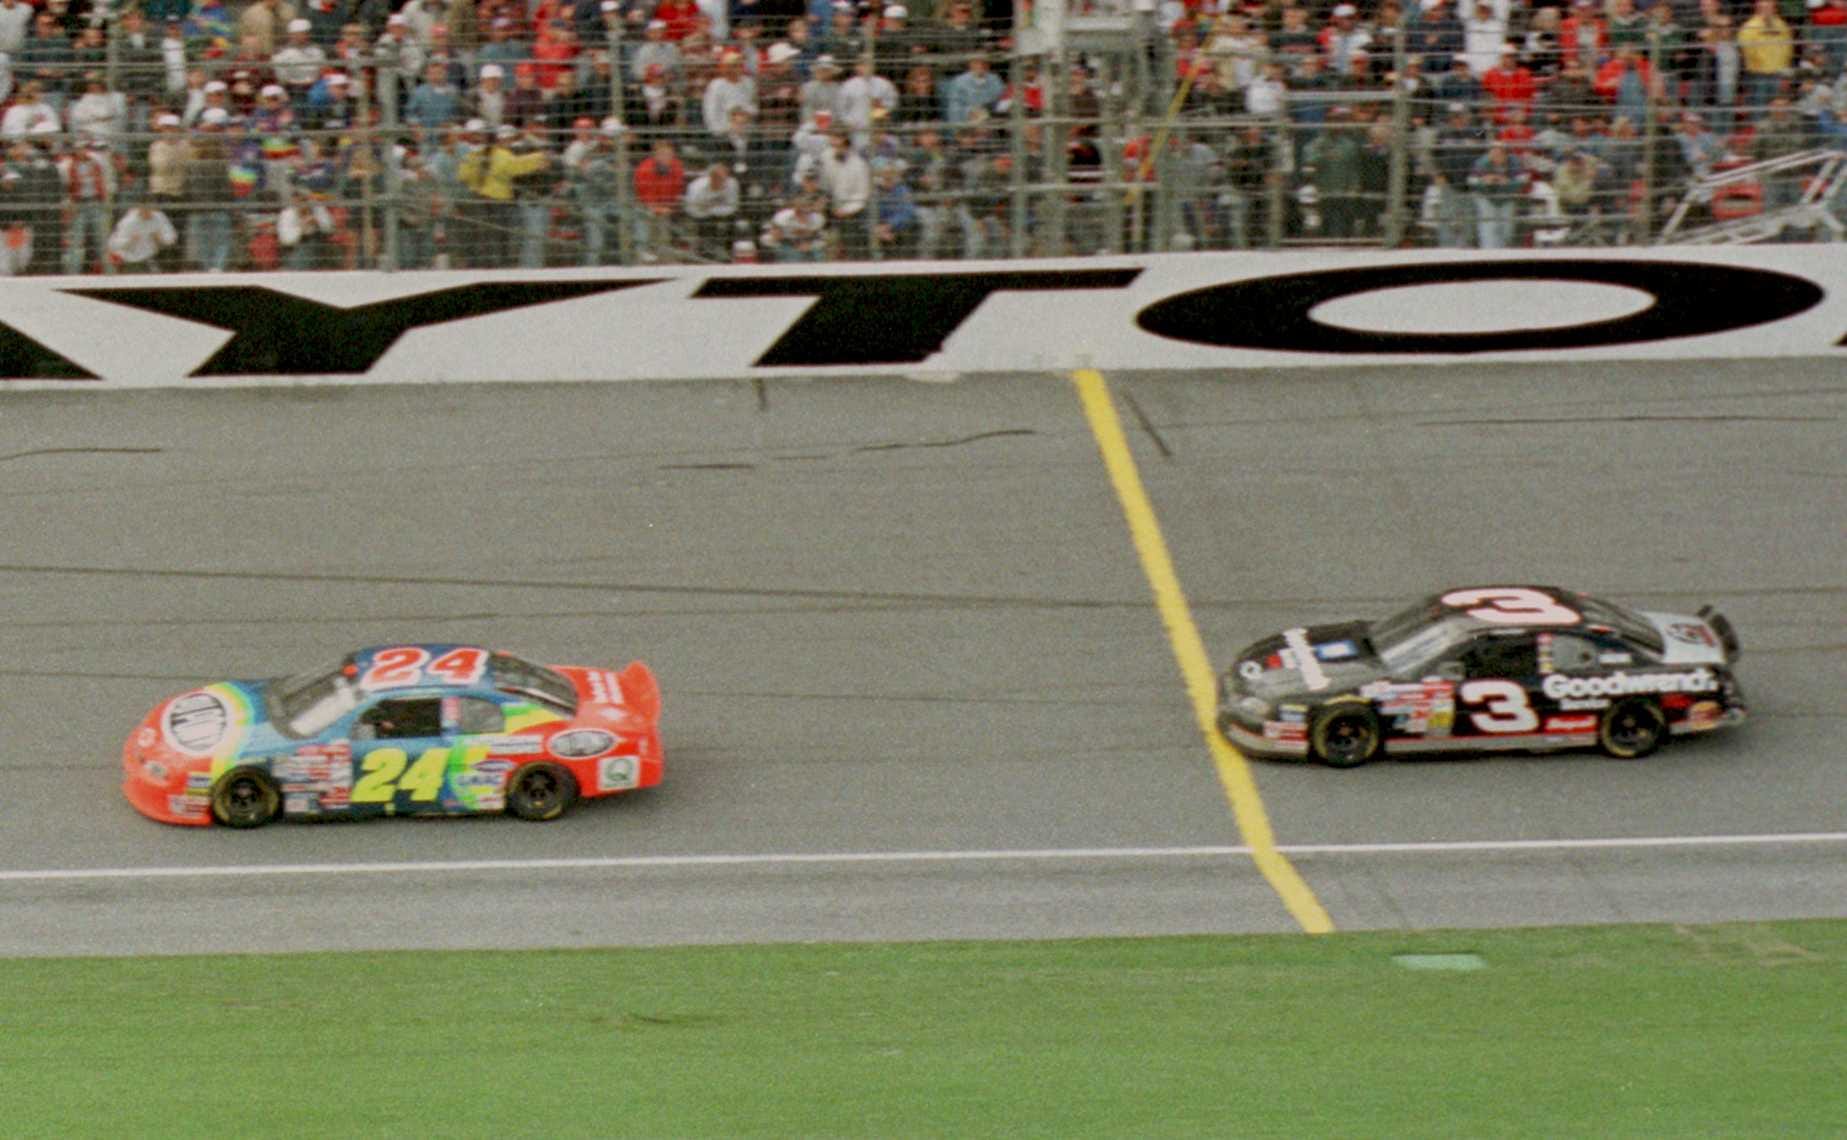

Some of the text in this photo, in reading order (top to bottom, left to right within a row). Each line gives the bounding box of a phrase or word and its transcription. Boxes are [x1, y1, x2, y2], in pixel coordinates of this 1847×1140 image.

[0, 258, 1847, 380] YTO
[1441, 587, 1583, 626] 3
[360, 646, 490, 690] 24
[1459, 679, 1540, 734] 3
[351, 747, 450, 803] 24
